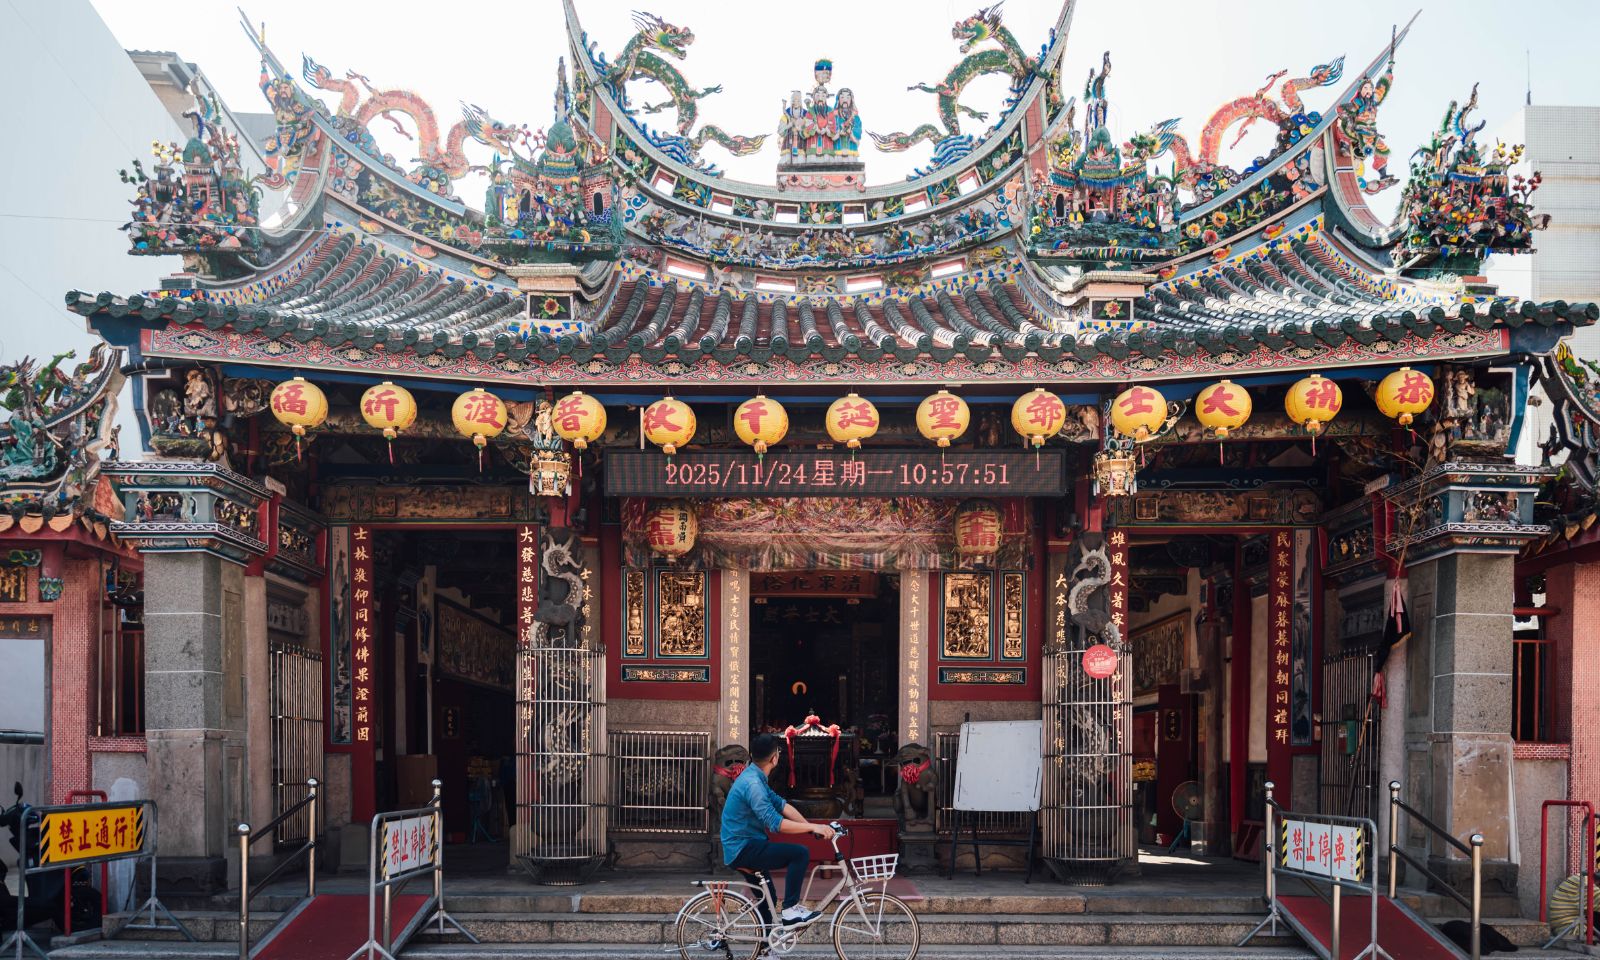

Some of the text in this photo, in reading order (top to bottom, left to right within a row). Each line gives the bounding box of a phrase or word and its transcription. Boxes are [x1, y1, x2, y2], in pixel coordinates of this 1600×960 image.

[273, 384, 308, 416] 福
[1118, 387, 1154, 417] 士
[1202, 385, 1241, 417] 大
[1304, 379, 1341, 412] 祝
[1392, 372, 1434, 405] 恭
[364, 389, 400, 422] 祈
[464, 394, 504, 429] 渡
[553, 396, 589, 432] 普
[643, 403, 683, 436] 秋
[740, 401, 769, 435] 千
[835, 401, 878, 430] 誕
[928, 398, 962, 430] 聖
[1026, 394, 1063, 431] 爺
[665, 460, 1010, 487] 2025/11/24 星期一 10:57:51
[58, 815, 129, 855] 禁止通行
[391, 824, 427, 866] 禁止停車
[1292, 828, 1347, 870] 禁止停車
